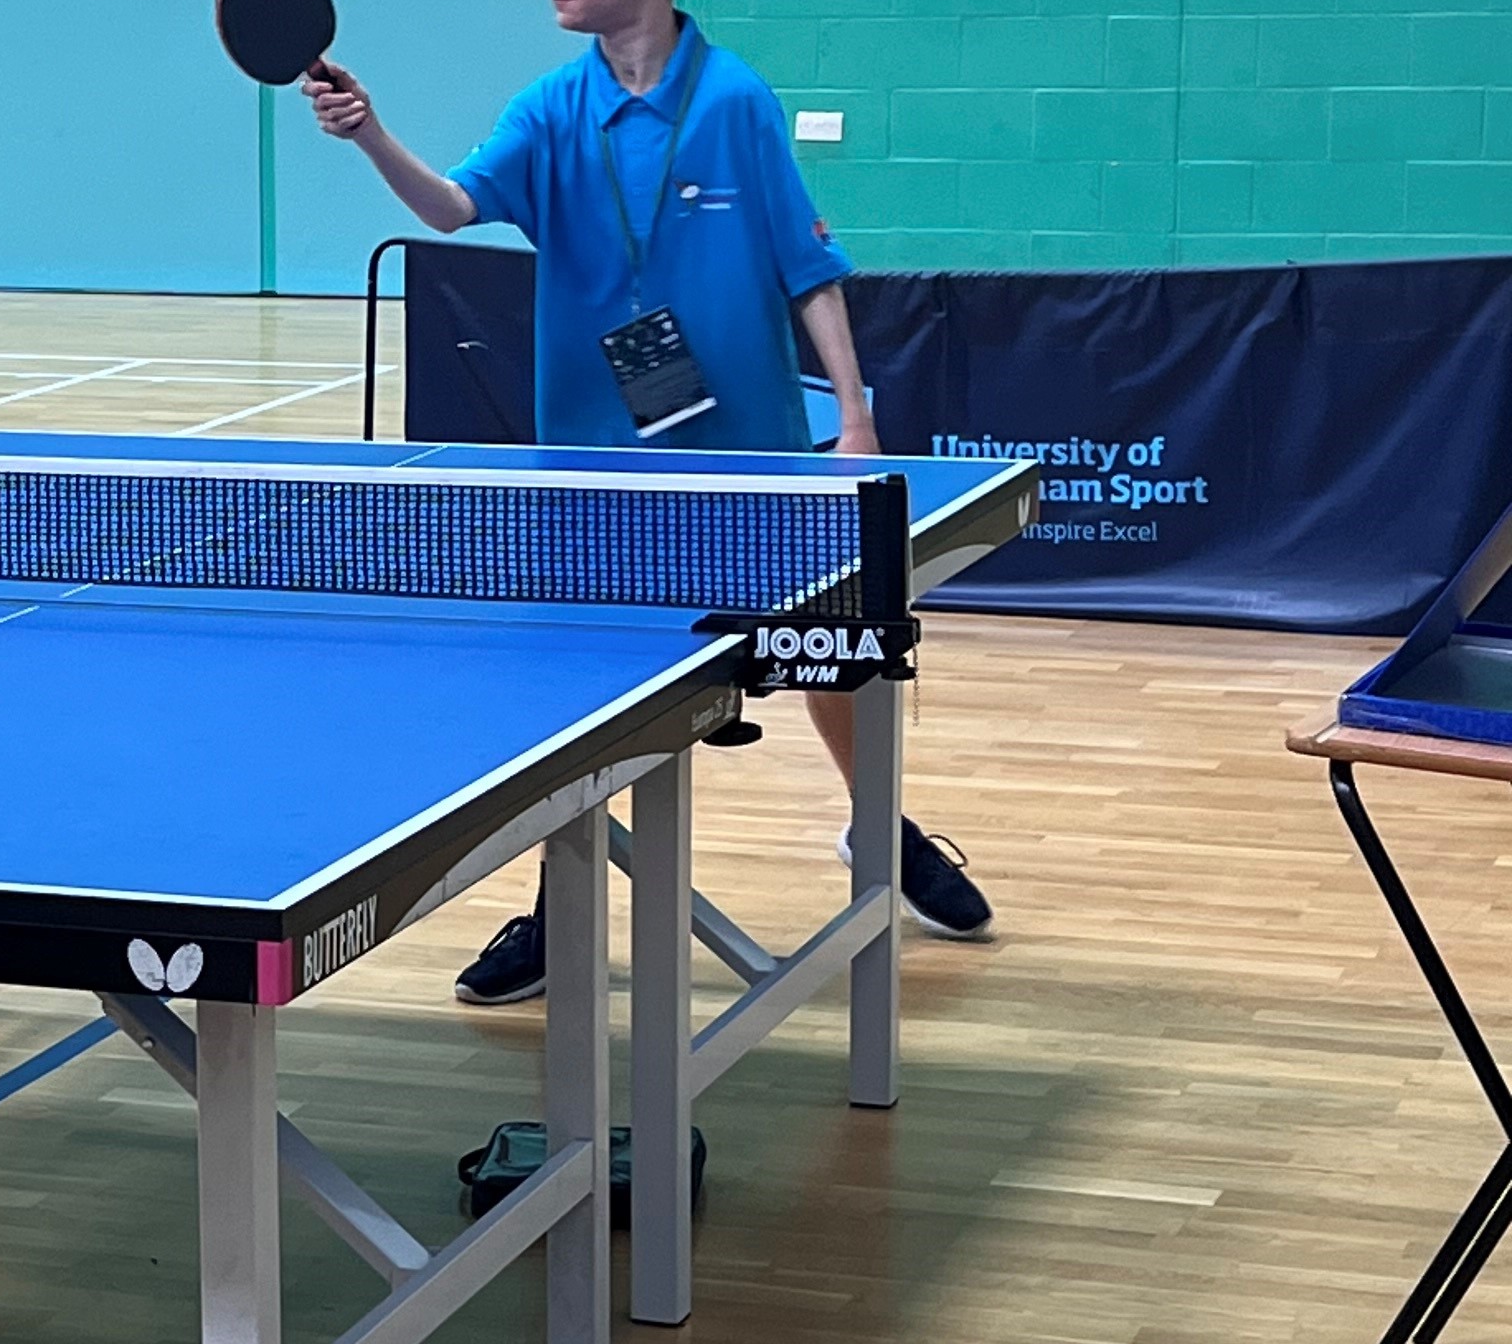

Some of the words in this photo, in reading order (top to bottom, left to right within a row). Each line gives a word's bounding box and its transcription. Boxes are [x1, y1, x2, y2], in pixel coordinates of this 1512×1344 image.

[932, 434, 1120, 472] University
[1127, 436, 1165, 466] of
[1110, 474, 1209, 510] Sport
[1100, 522, 1158, 542] Excel
[754, 627, 885, 660] JOOLA
[796, 665, 840, 683] WM
[303, 893, 378, 988] BUTTERFLY
